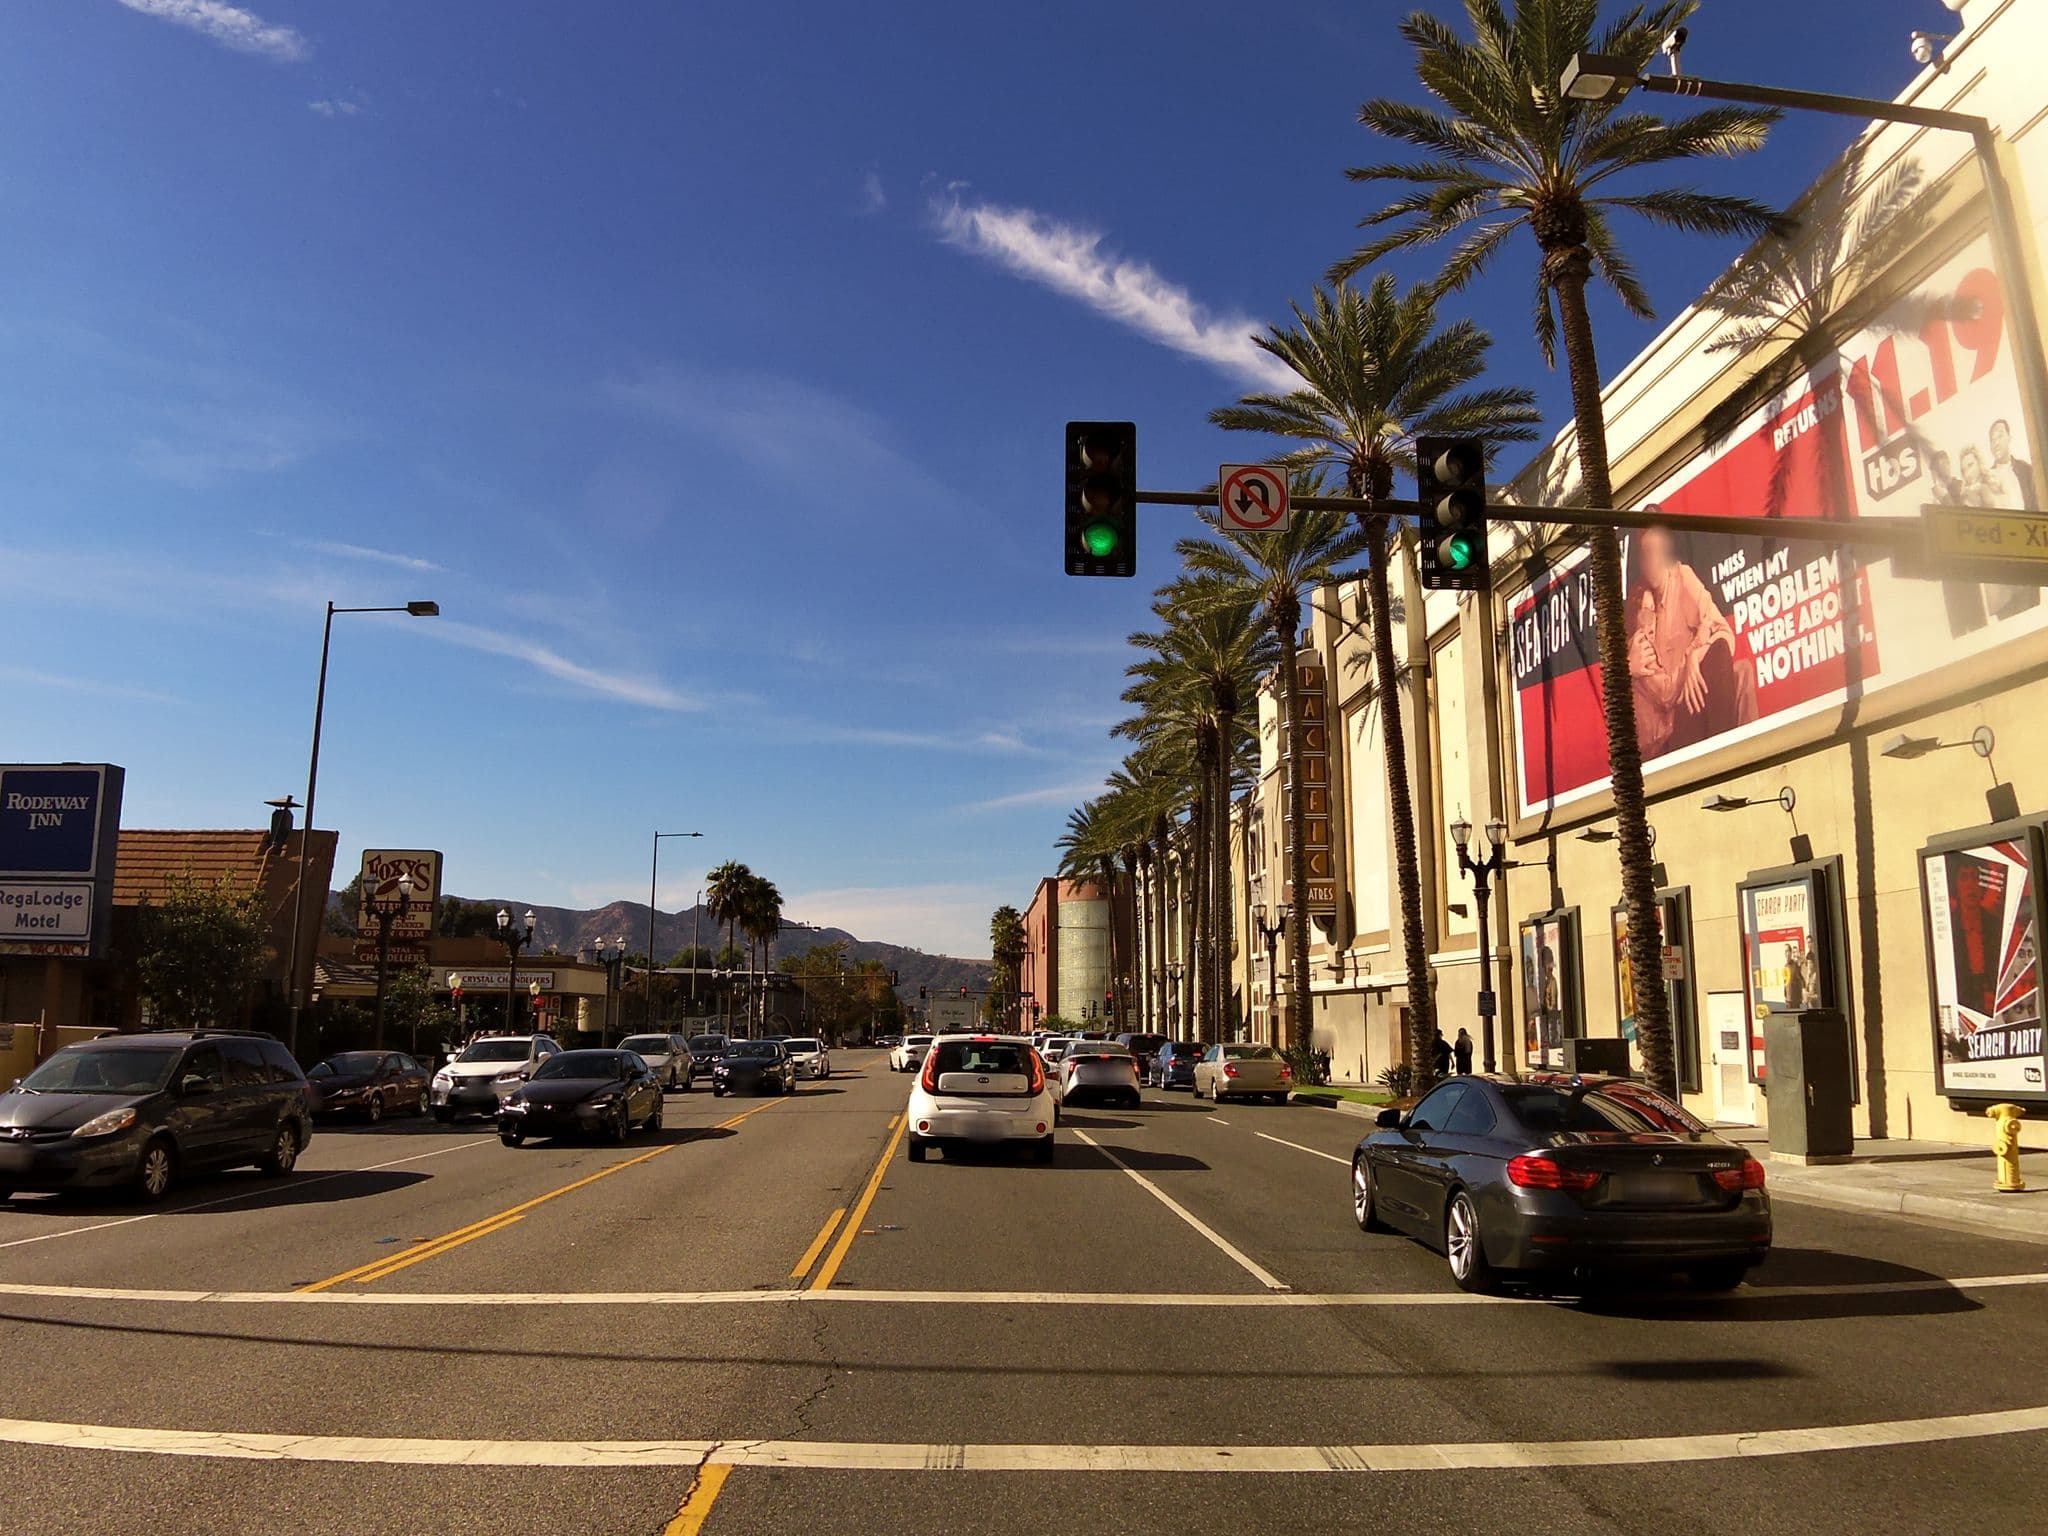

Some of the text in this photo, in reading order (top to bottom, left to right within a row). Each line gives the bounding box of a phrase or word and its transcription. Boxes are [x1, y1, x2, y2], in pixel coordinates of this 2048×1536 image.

[1845, 267, 2005, 454] 11.19
[1773, 388, 1838, 452] RETURNS
[1867, 447, 1917, 493] tbs
[1711, 549, 1746, 584] I MISS
[1721, 547, 1789, 603] WHEN MY
[1516, 526, 1629, 678] SEARCH PAY
[1748, 612, 1795, 655] WERE
[1303, 667, 1321, 873] PACIFIC
[6, 793, 90, 810] RODEWAY
[28, 813, 63, 830] INN
[0, 890, 84, 909] RegaLodge
[1308, 886, 1334, 900] ATRES
[1757, 893, 1805, 917] SEARCH PARTY
[15, 913, 60, 928] Motel
[360, 902, 433, 913] RSTAUANT
[360, 953, 426, 963] CHADELIERS
[462, 975, 550, 984] CRYSTAL CHNDELIERS
[1968, 1028, 2042, 1059] SEARCH PARTY
